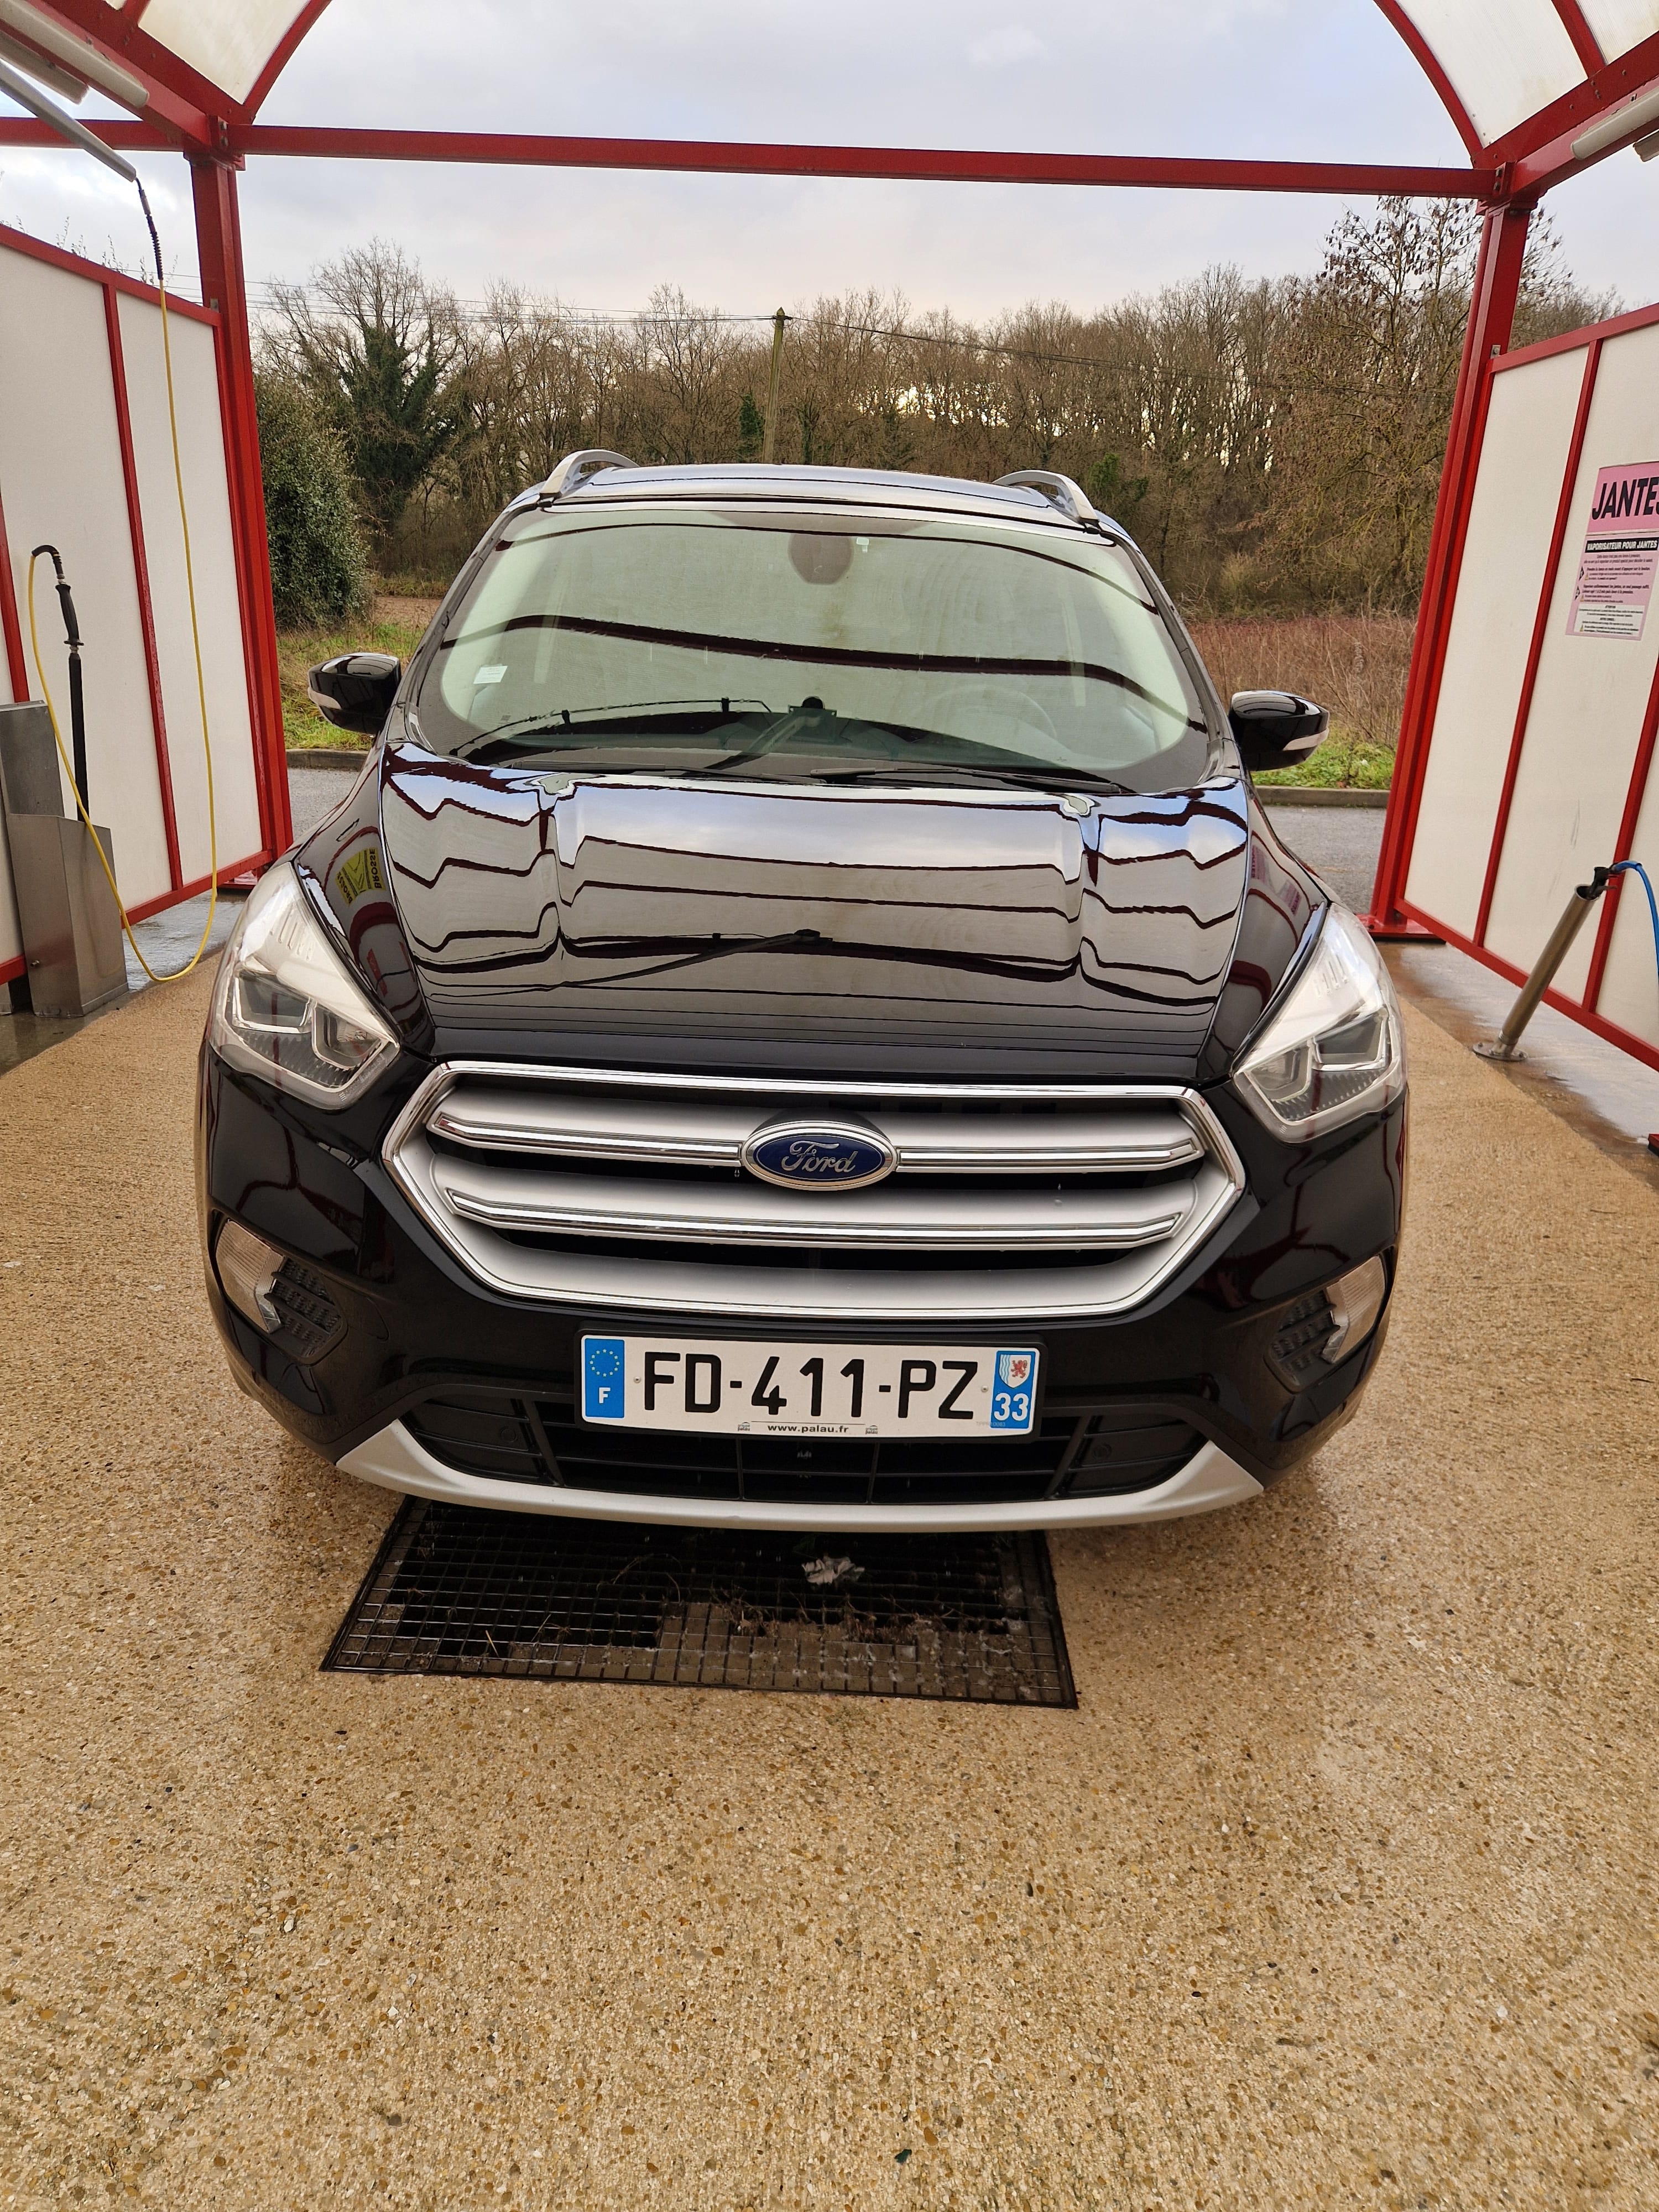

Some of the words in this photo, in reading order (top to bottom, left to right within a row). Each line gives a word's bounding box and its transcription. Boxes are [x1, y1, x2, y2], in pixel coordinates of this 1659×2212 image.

[1592, 477, 1659, 520] JANTE
[1587, 541, 1622, 551] VAPORISATEUR
[1623, 541, 1636, 549] POUR
[1637, 540, 1657, 549] JANTES
[781, 1140, 858, 1173] Ford
[598, 1387, 609, 1404] F
[644, 1352, 978, 1420] FD-411-PZ
[994, 1392, 1029, 1421] 33
[768, 1425, 849, 1433] www.palau.fr
